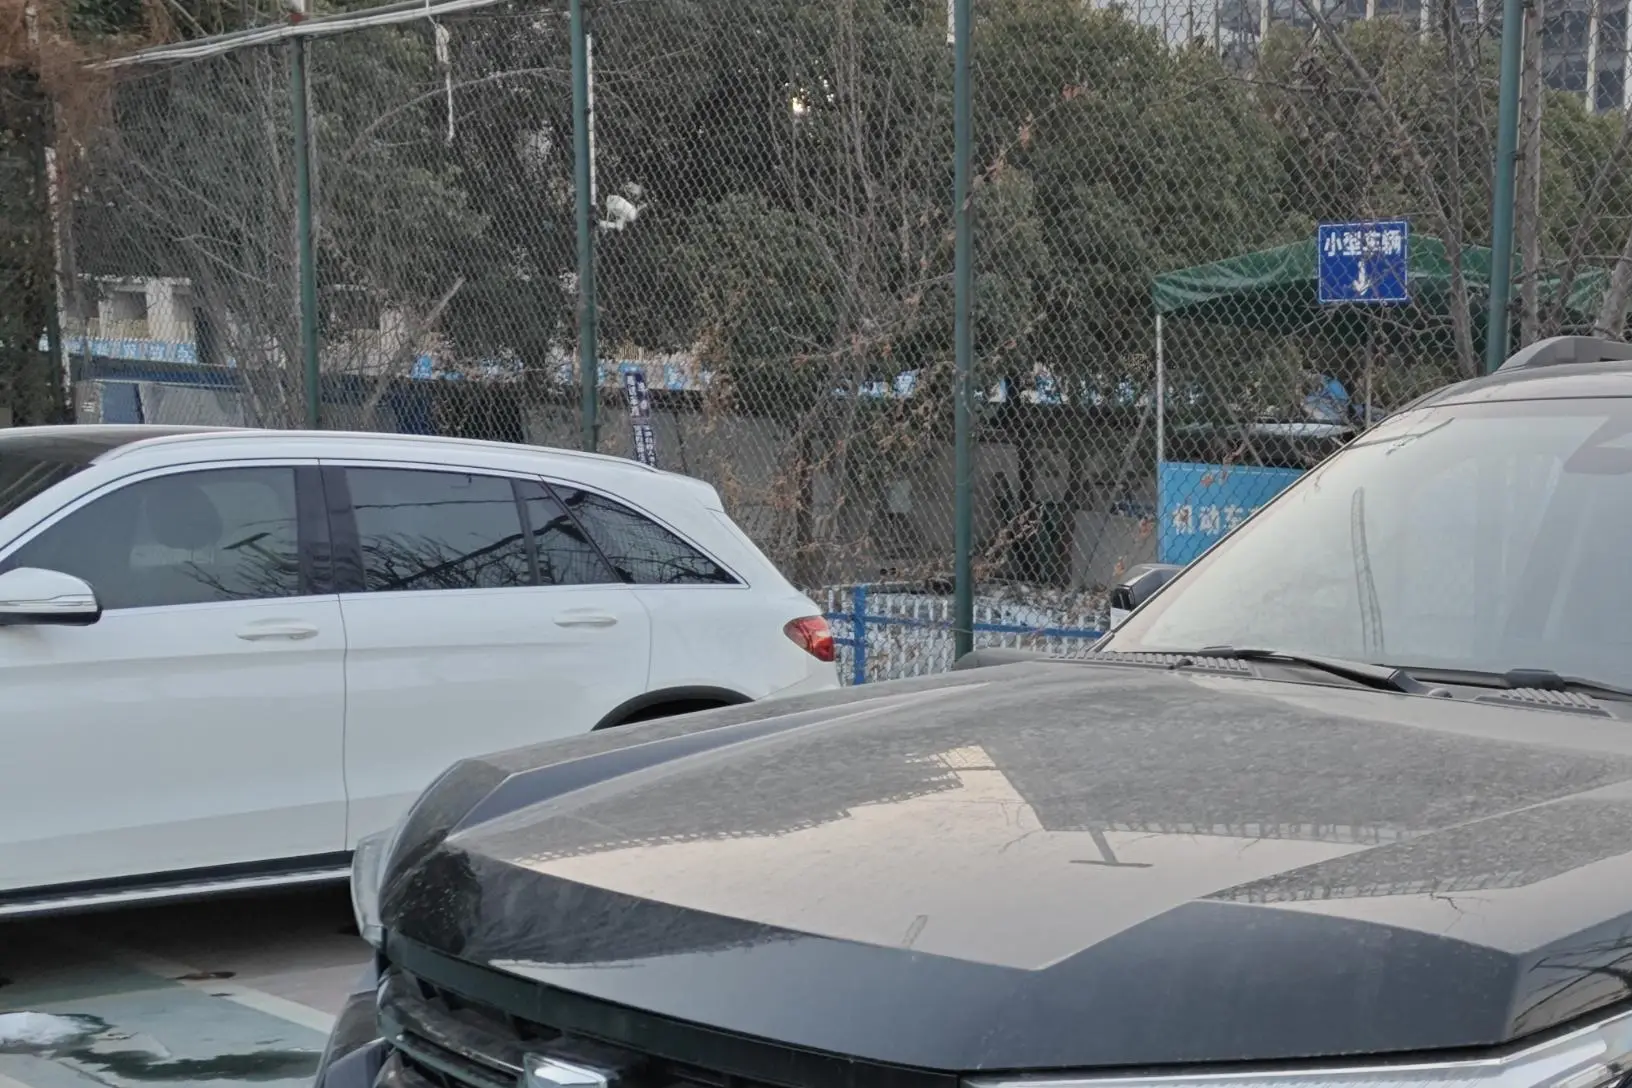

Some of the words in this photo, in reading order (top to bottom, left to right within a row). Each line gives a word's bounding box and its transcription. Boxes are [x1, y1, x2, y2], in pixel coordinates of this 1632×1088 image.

[1324, 230, 1401, 257] 小型车辆
[1171, 502, 1259, 535] 机动车
